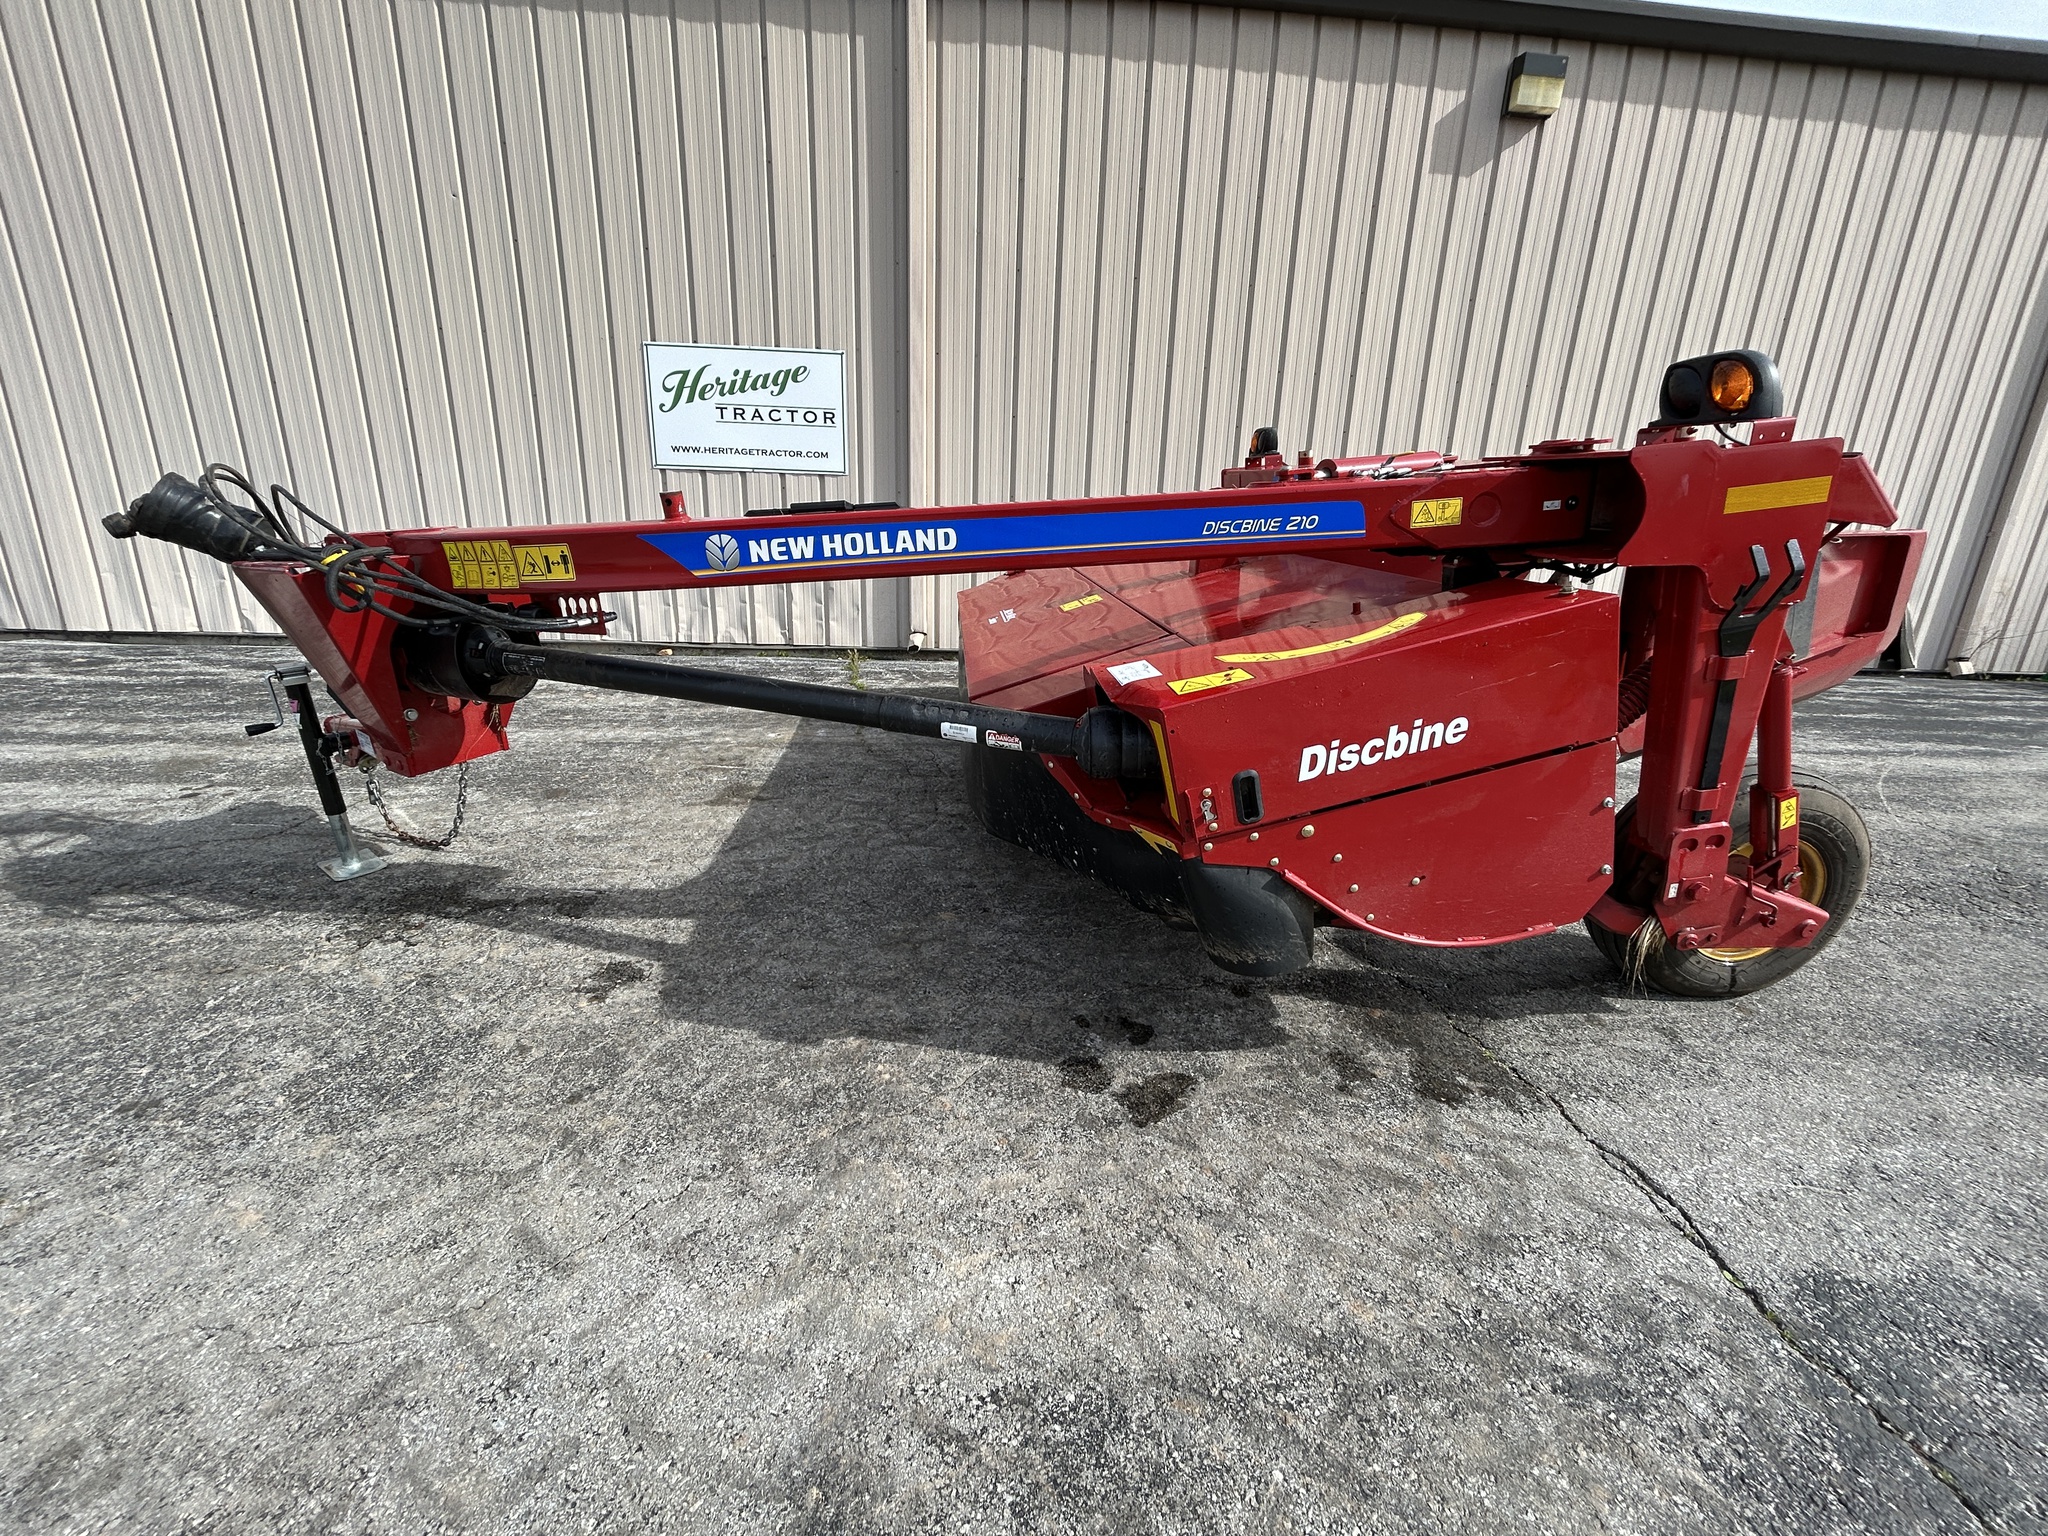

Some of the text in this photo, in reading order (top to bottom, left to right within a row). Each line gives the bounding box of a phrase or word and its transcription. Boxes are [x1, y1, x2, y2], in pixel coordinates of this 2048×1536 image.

[659, 364, 810, 412] Heritage
[715, 407, 836, 424] TRACTOR
[671, 445, 829, 459] WWW.HERITAGETRACTOR.COM
[1202, 518, 1282, 535] DISCBINE
[749, 528, 957, 562] NEW HOLLAND
[995, 735, 1020, 743] DANGER
[1298, 716, 1469, 782] Discbine
